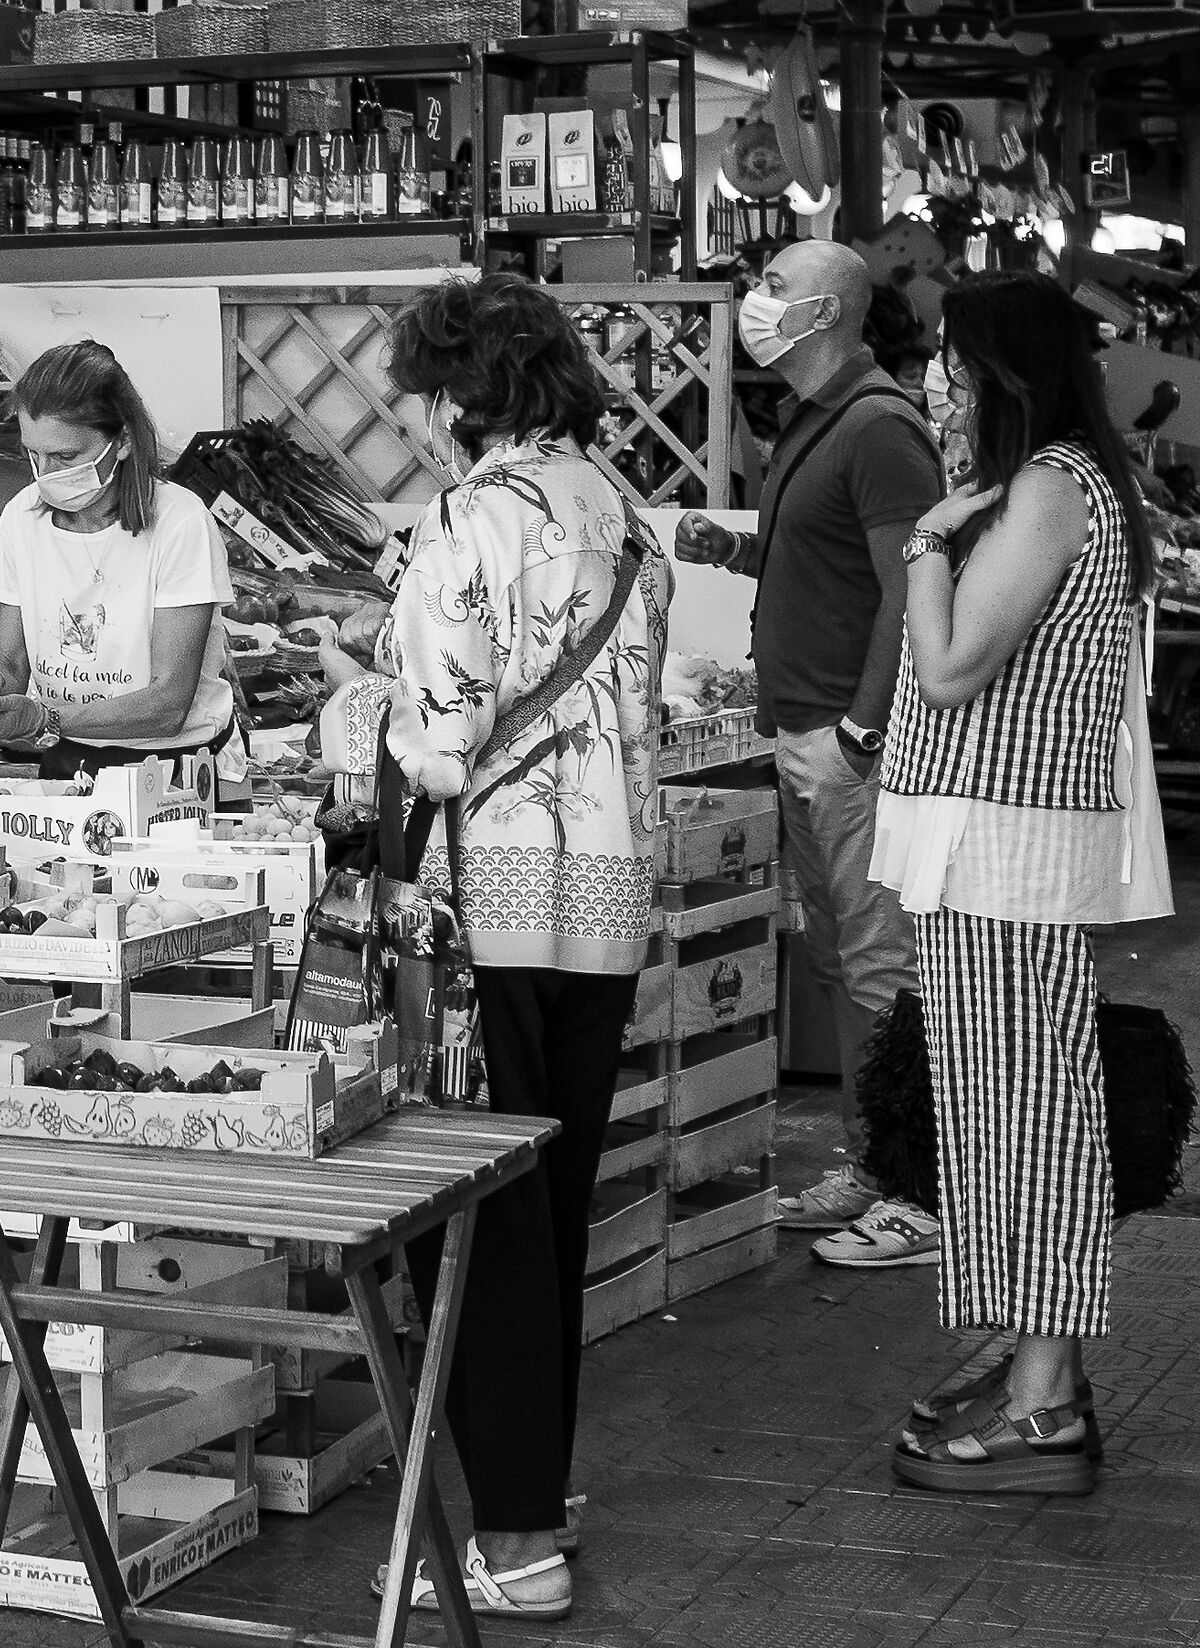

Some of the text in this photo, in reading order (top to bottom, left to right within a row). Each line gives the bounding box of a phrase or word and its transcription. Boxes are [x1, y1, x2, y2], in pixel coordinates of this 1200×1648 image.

[509, 196, 539, 213] bio
[559, 195, 590, 213] bio
[96, 669, 133, 685] male
[154, 1545, 197, 1586] ENRICO
[206, 1509, 257, 1554] MATTEO
